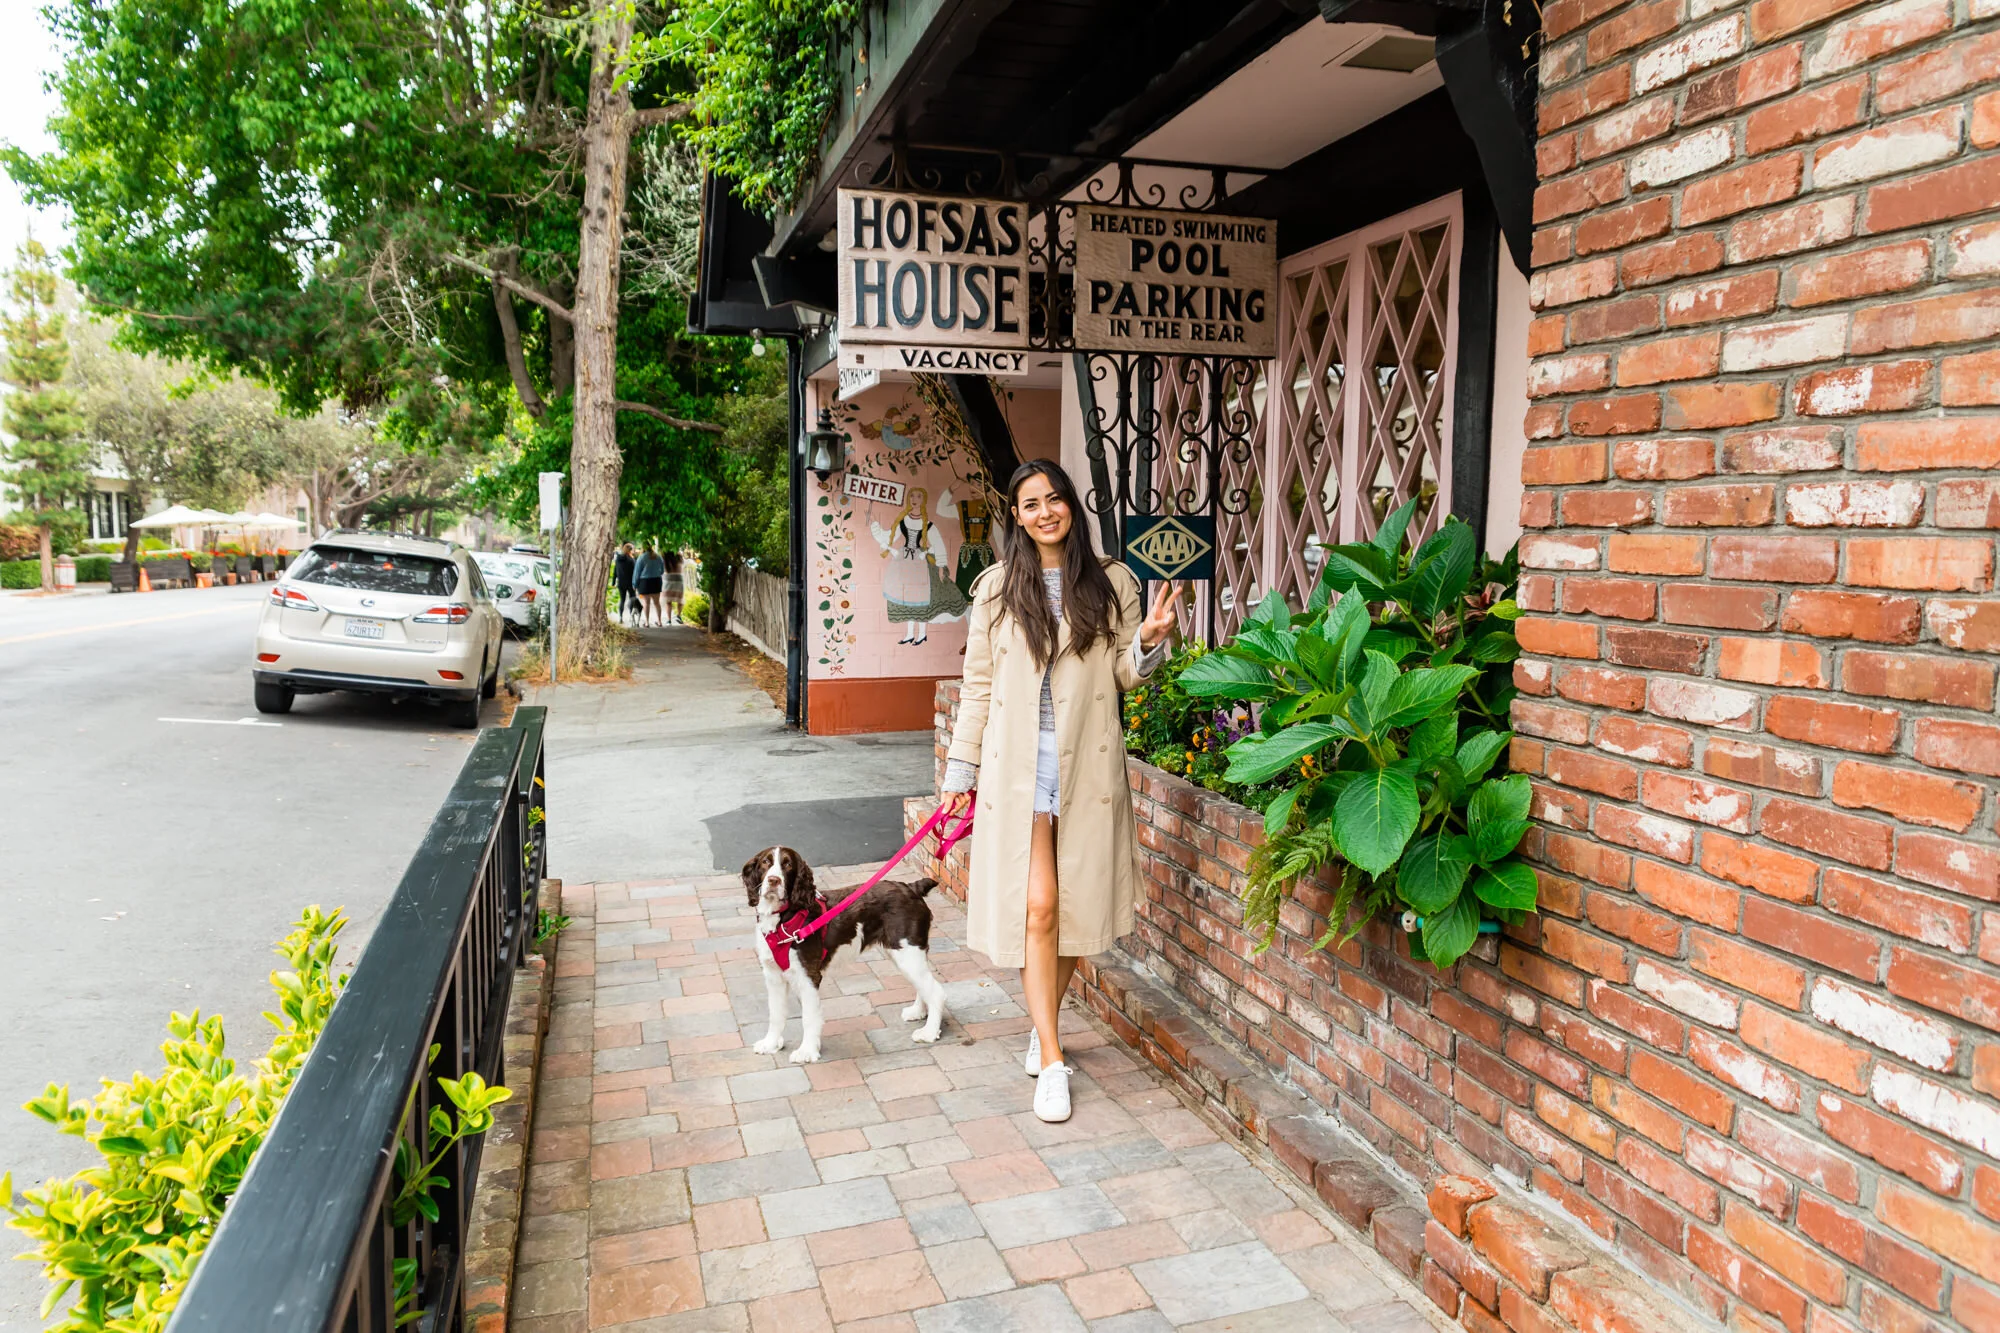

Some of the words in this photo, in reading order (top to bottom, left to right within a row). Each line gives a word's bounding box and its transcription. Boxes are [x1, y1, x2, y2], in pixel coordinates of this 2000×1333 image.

[854, 197, 1020, 255] HOFSAS
[1089, 213, 1166, 236] HEATED
[1173, 219, 1266, 243] SWIMMING
[1131, 238, 1229, 277] POOL
[854, 259, 1019, 332] HOUSE
[1090, 280, 1265, 322] PARKING
[1109, 319, 1131, 337] IN
[1140, 322, 1180, 339] THE
[1191, 325, 1244, 342] REAR
[901, 350, 1024, 370] VACANCY
[849, 478, 897, 501] ENTER
[1147, 530, 1191, 563] AAA
